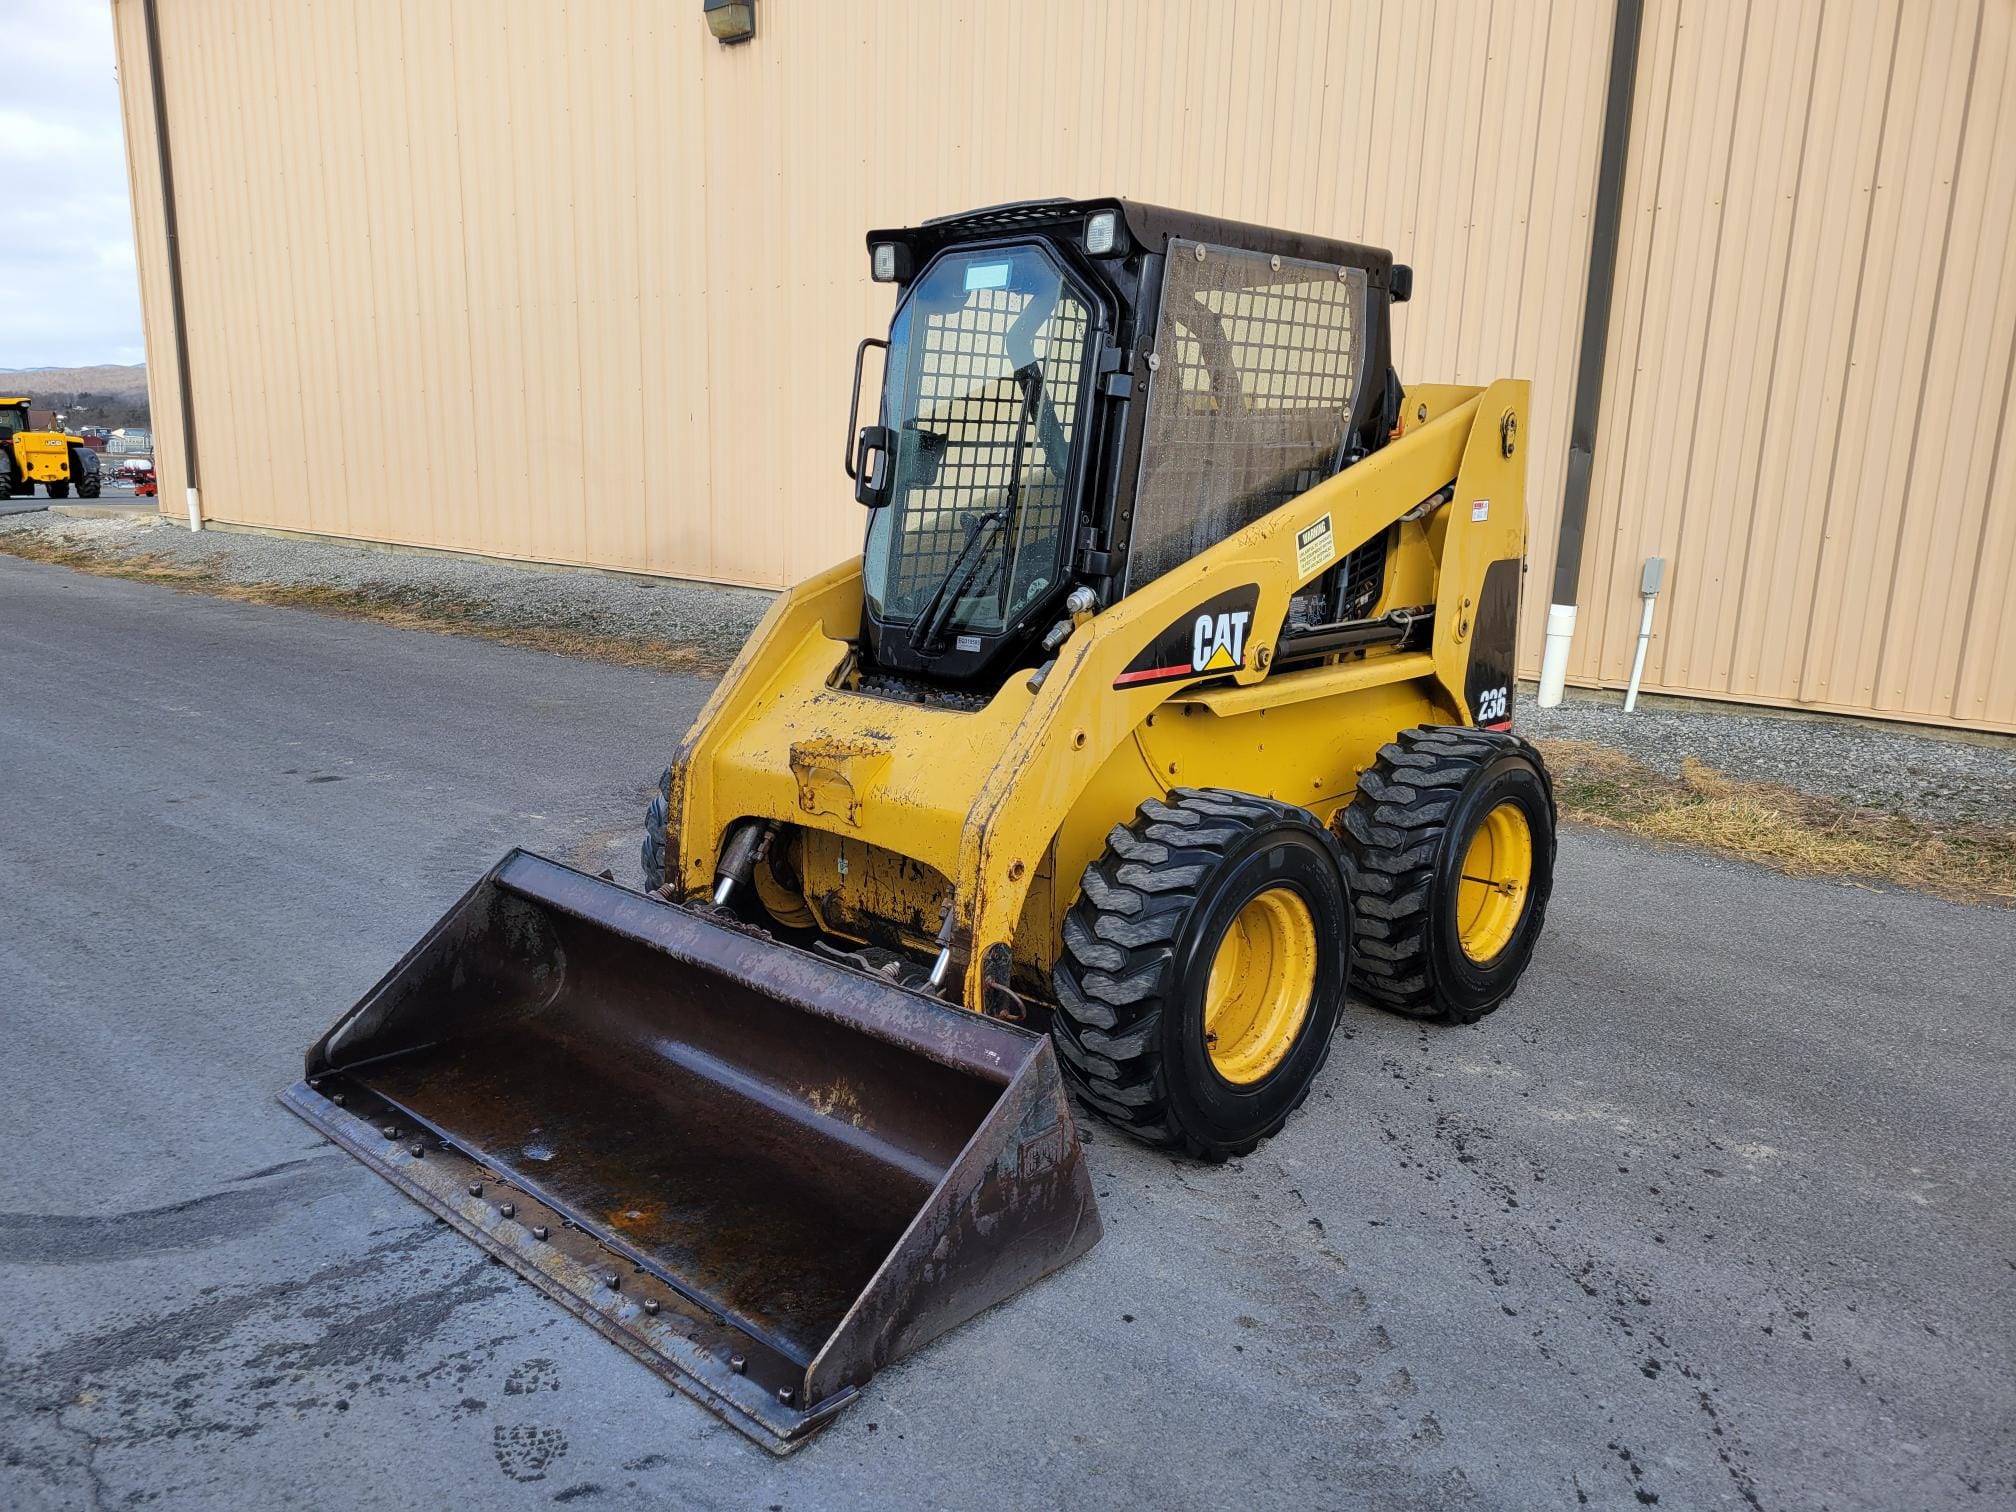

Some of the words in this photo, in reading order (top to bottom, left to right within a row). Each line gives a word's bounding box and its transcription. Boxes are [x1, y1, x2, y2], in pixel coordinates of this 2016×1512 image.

[1302, 520, 1326, 545] WARNING
[1193, 611, 1249, 671] CAT
[1478, 687, 1506, 721] 236
